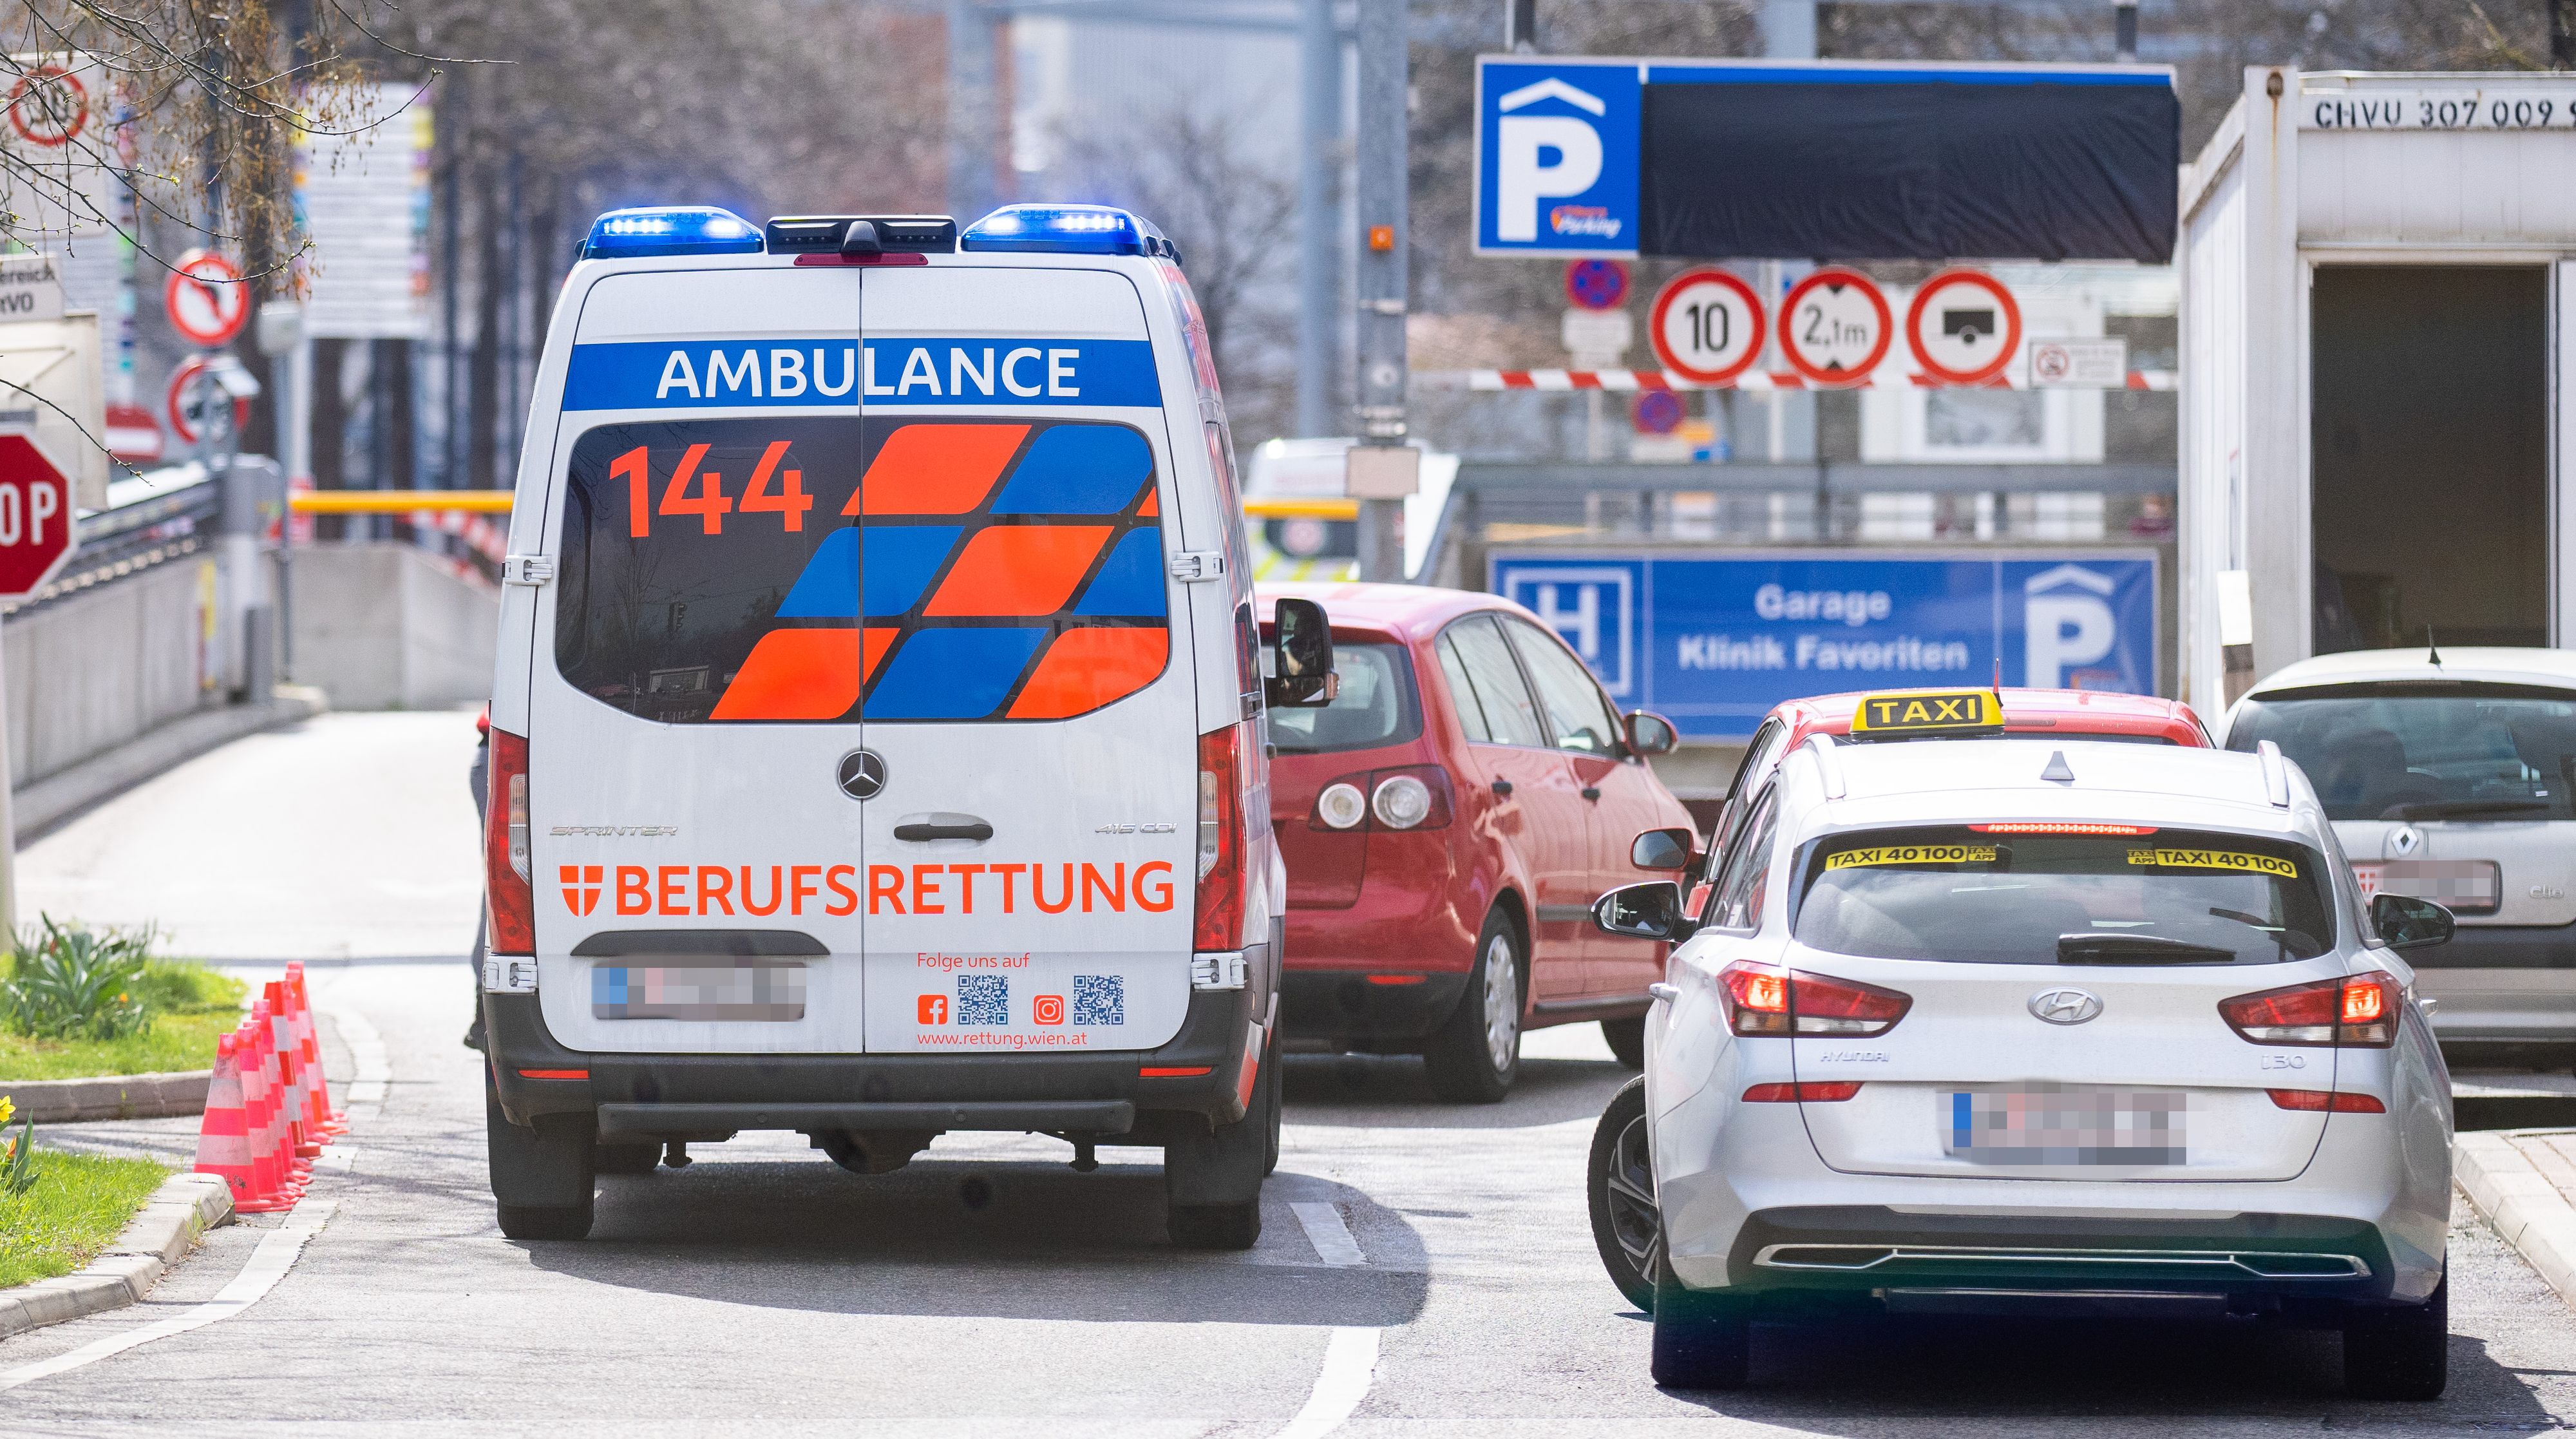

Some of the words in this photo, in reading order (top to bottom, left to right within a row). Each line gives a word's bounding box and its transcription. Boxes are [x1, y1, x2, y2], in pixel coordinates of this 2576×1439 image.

[2316, 99, 2401, 128] CHVU
[2420, 99, 2477, 128] 307
[2492, 98, 2553, 127] 009
[1498, 115, 1604, 242] P
[1687, 302, 1728, 352] 10
[656, 347, 1081, 398] AMBULANCE
[609, 441, 813, 538] 144
[0, 482, 58, 548] OP
[1755, 583, 1893, 627] Garage
[1678, 634, 1787, 671] Klinik
[1795, 634, 1969, 671] Favoriten
[2025, 596, 2116, 689] P
[1872, 698, 1976, 723] TAXI
[549, 825, 677, 836] SPRINTER
[1140, 823, 1177, 834] CDI
[1830, 850, 1880, 867] TAXI
[1886, 847, 1964, 861] 40100
[2158, 851, 2211, 865] TAXI
[2218, 853, 2293, 874] 40100
[616, 860, 1174, 917] BERUFSRETTUNG
[918, 953, 963, 971] Folge
[968, 956, 998, 967] uns
[1003, 952, 1030, 967] auf
[917, 1031, 1088, 1049] www.rettung.wien.at
[1821, 1051, 1889, 1062] HYUNDAI
